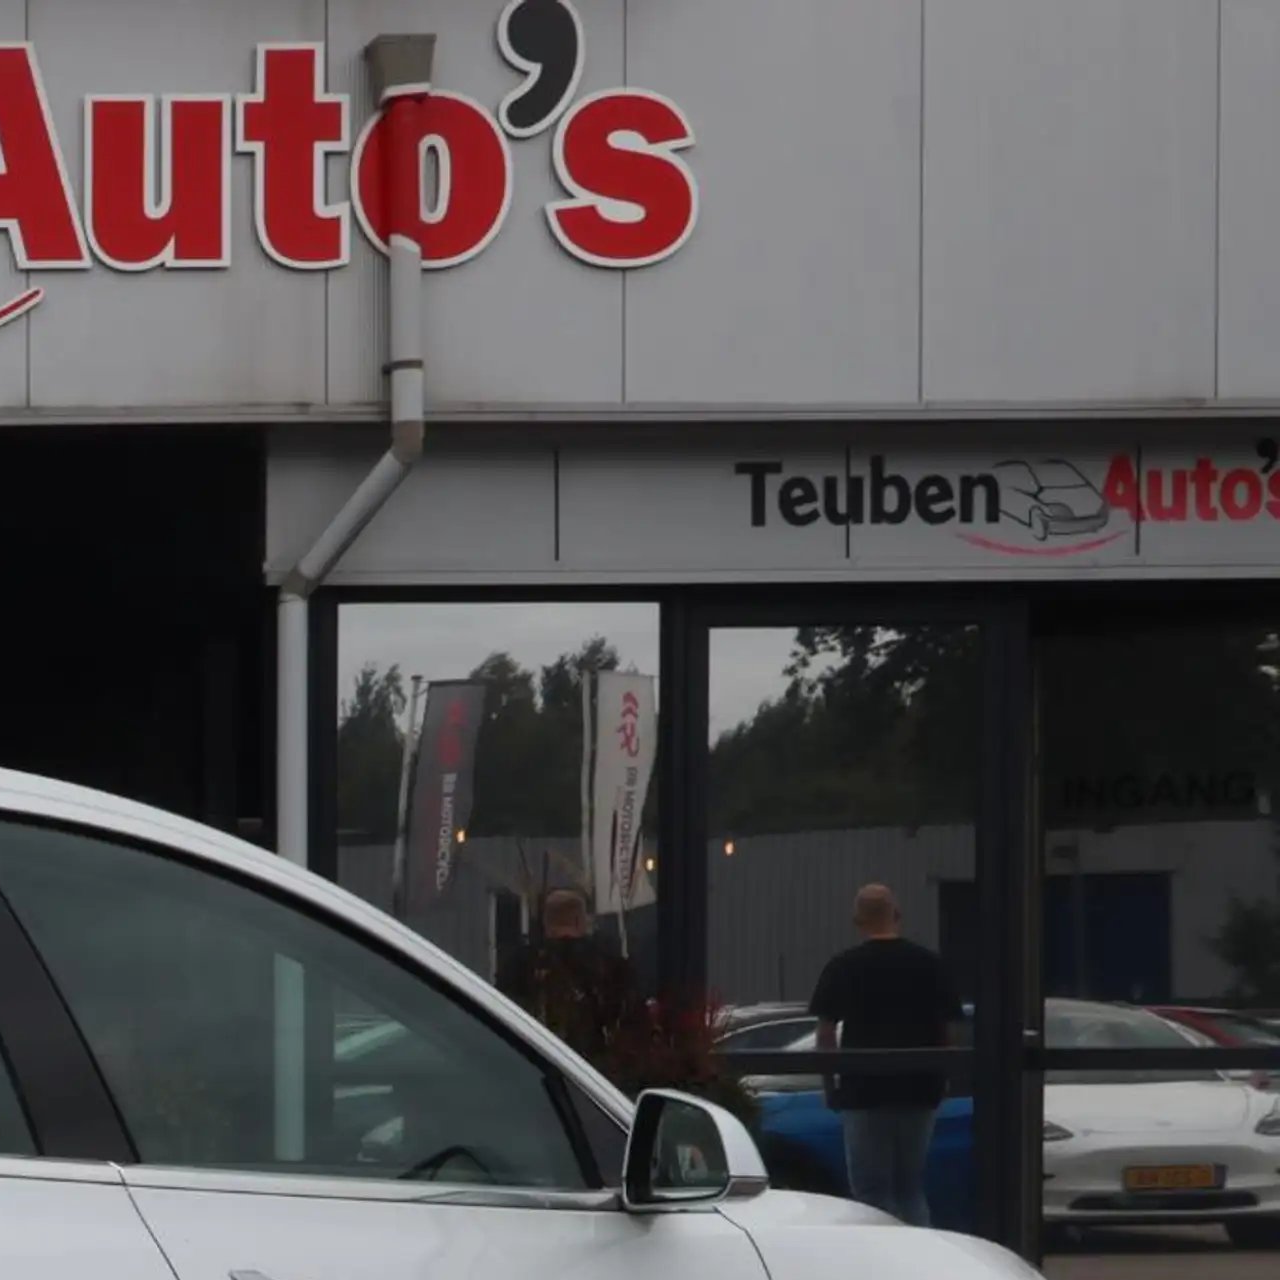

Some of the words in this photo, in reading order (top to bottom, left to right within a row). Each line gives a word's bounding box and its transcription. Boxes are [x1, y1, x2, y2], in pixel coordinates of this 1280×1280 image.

[735, 455, 1001, 527] Teuben
[1102, 438, 1280, 522] Auto'
[1061, 770, 1256, 808] INGANG
